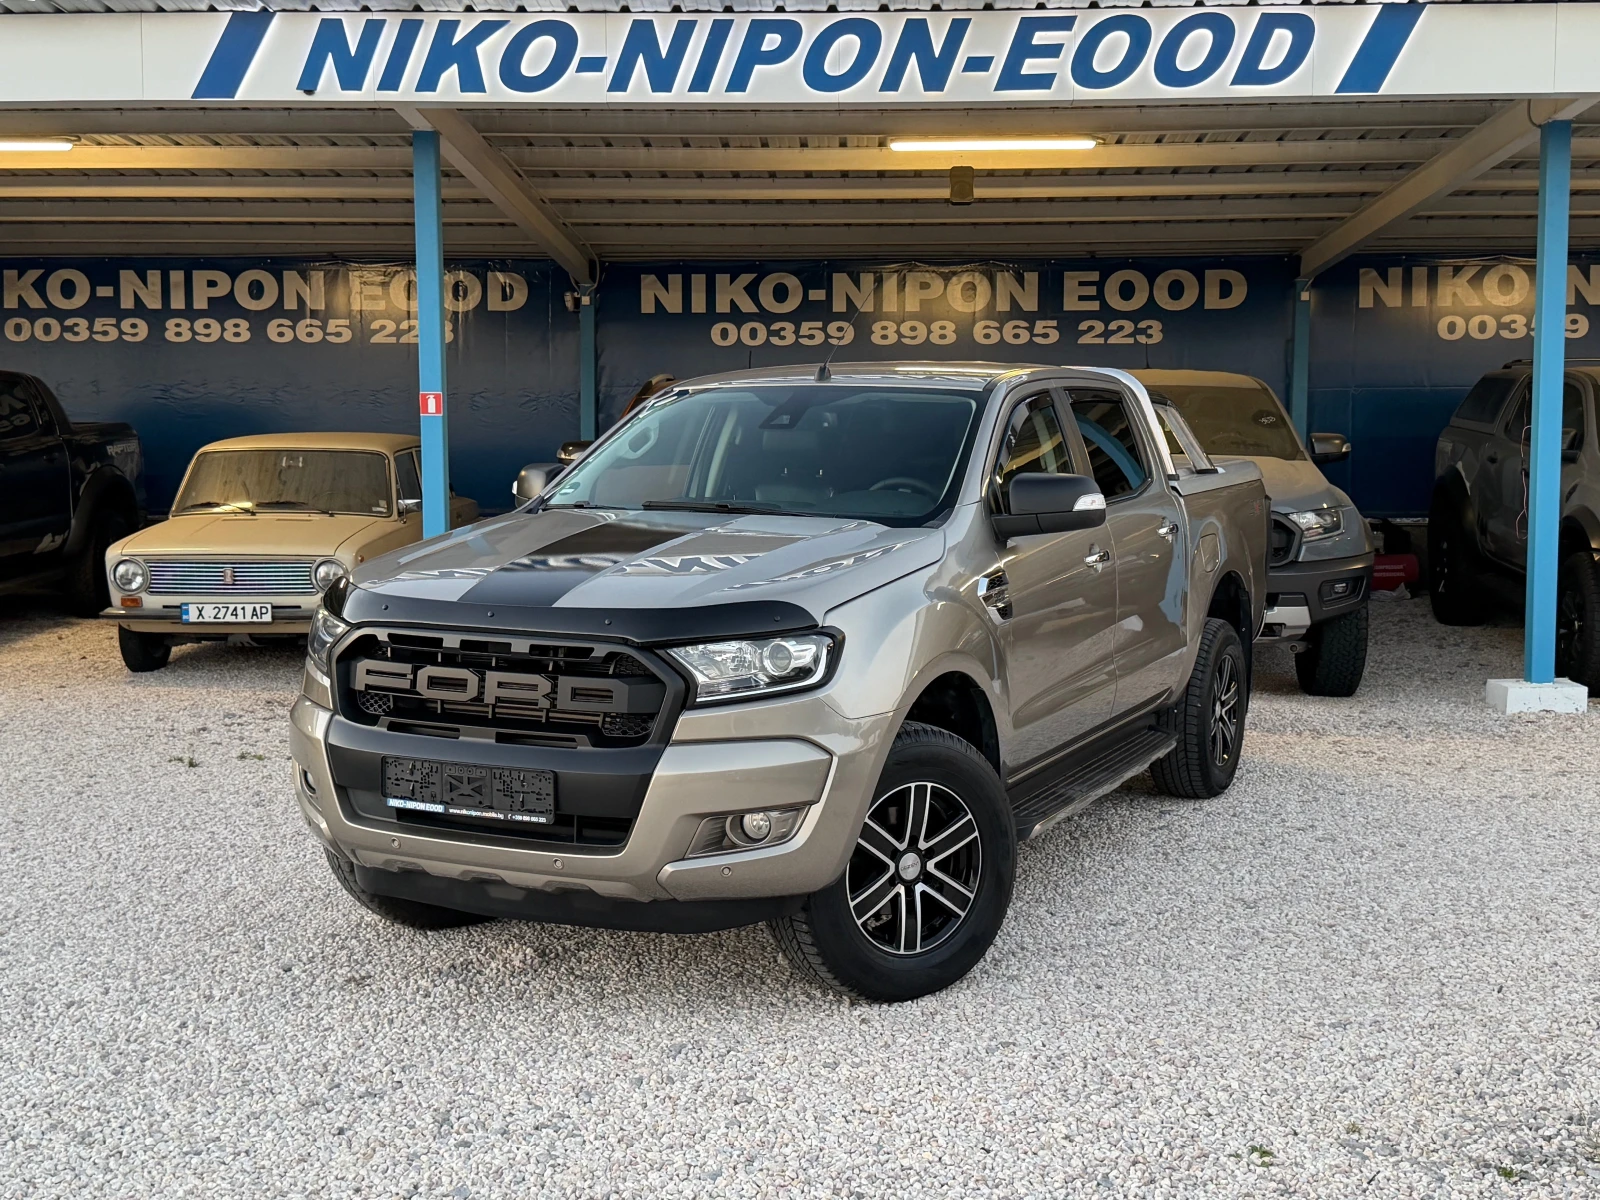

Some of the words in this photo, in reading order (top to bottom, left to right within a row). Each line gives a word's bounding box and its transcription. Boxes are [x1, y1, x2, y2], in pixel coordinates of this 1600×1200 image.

[296, 12, 1316, 94] NIKO-NIPON-EOOD
[351, 269, 529, 312] EOOD
[640, 271, 1038, 313] NIKO-NIPON
[1063, 269, 1248, 311] EOOD
[1359, 264, 1600, 308] NIKON
[4, 317, 149, 342] 00359
[164, 318, 251, 343] 898
[266, 318, 352, 344] 665
[710, 320, 855, 347] 00359
[870, 319, 957, 346] 898
[973, 319, 1060, 345] 665
[1077, 319, 1163, 345] 223
[1437, 313, 1590, 341] 0039
[196, 606, 205, 620] X
[213, 606, 246, 620] 2741
[250, 606, 269, 620] AP
[355, 659, 630, 713] FORD
[425, 803, 443, 813] EOOD
